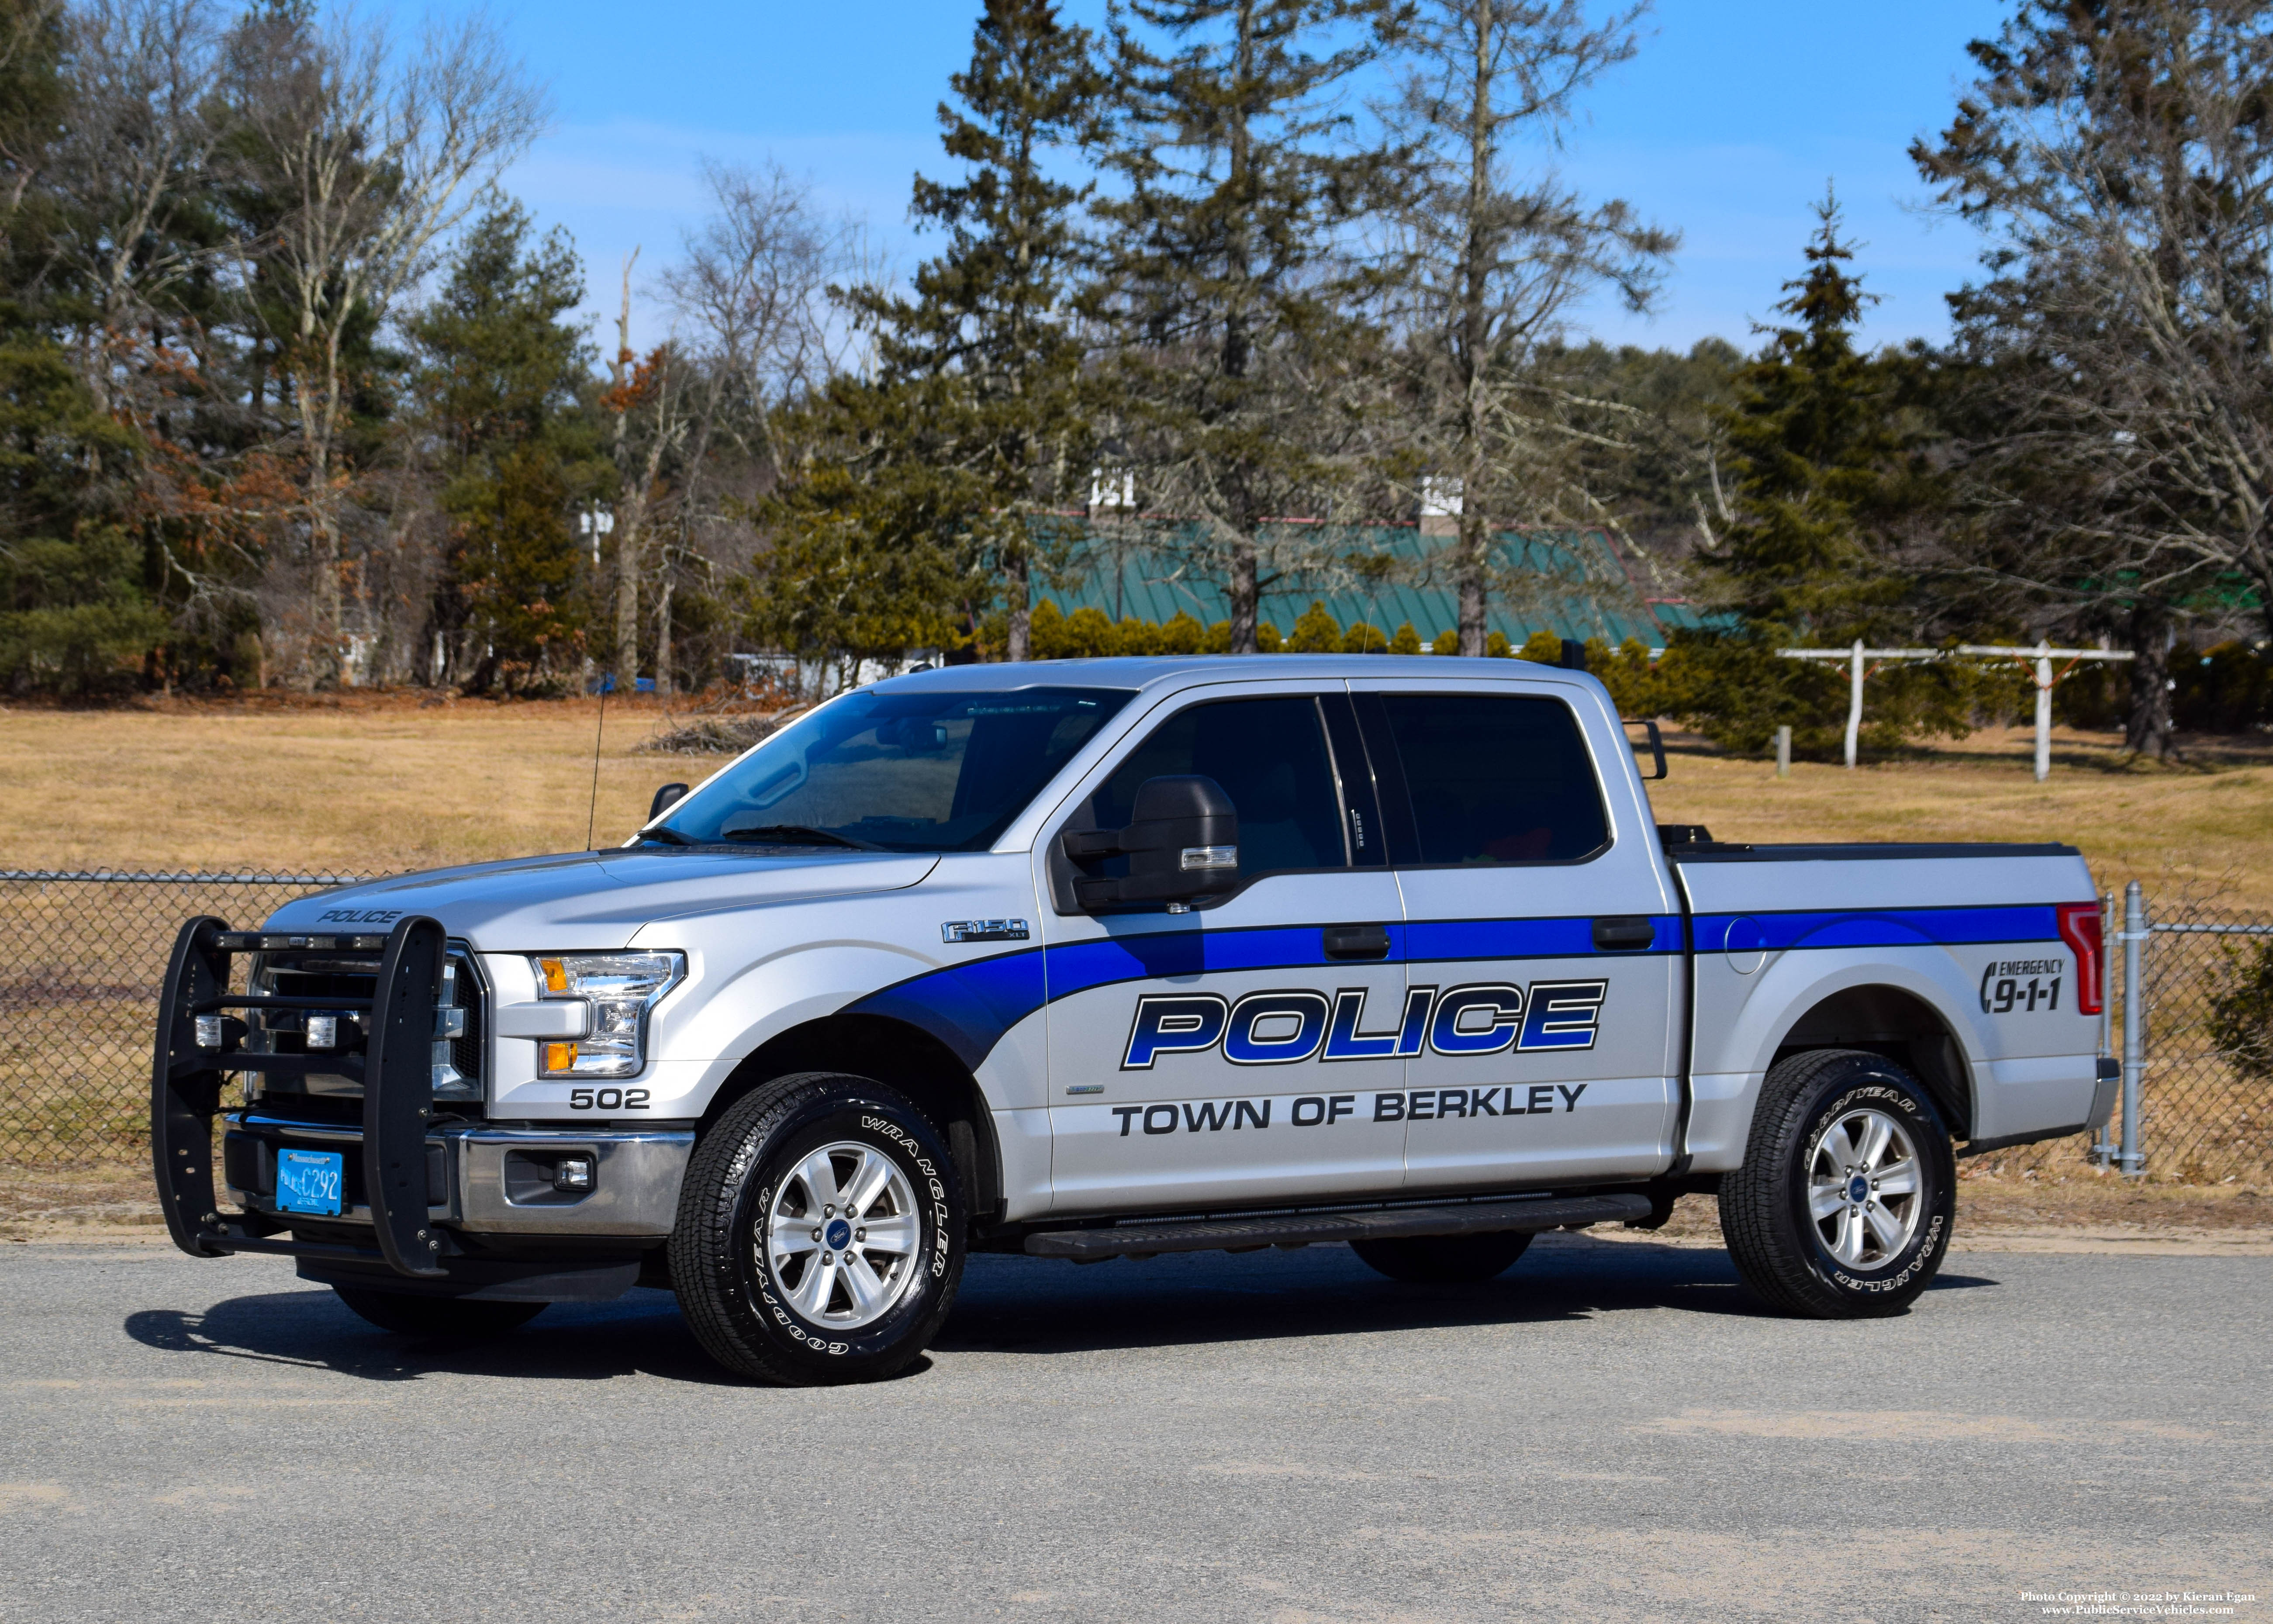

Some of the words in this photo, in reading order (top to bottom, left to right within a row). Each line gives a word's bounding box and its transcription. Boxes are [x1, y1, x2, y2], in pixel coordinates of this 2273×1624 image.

[316, 910, 404, 924] POLICE
[1993, 976, 2062, 1013] 9-1-1
[1999, 959, 2066, 976] EMERGENCY
[1119, 978, 1610, 1071] POLICE
[570, 1088, 650, 1110] 502
[1112, 1099, 1271, 1137] TOWN
[1291, 1095, 1355, 1127] OF
[1372, 1083, 1588, 1123] BERKLEY
[1803, 1086, 1916, 1170] GOODYEAR
[301, 1167, 338, 1200] C292
[862, 1116, 948, 1277] WRANGLER
[753, 1187, 849, 1354] GOODYEAR
[1834, 1216, 1943, 1291] WRANGLER
